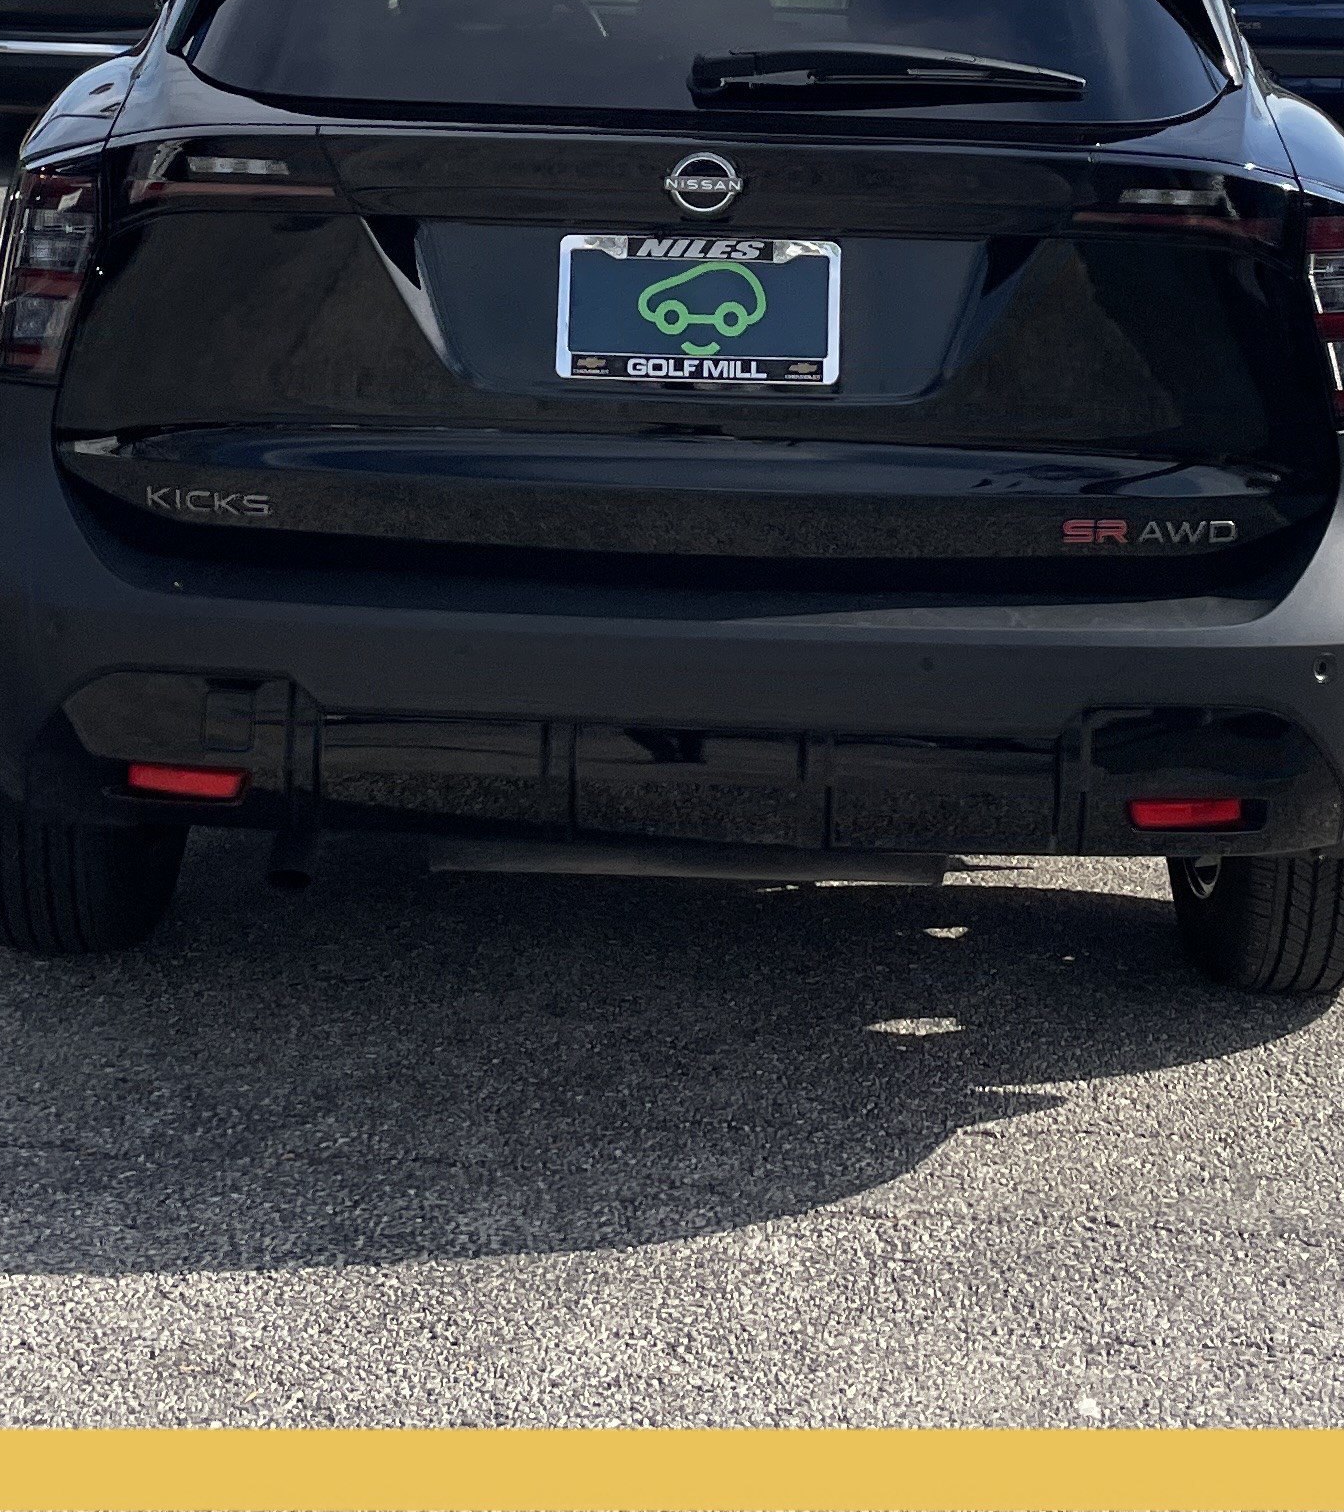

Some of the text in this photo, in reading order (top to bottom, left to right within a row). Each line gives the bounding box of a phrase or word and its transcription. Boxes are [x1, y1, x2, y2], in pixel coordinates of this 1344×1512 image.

[664, 178, 741, 190] NISSAN
[636, 239, 766, 259] NILES
[627, 358, 768, 379] GOLF MILL
[146, 485, 273, 516] KICKS
[1063, 519, 1238, 543] SR AWD
